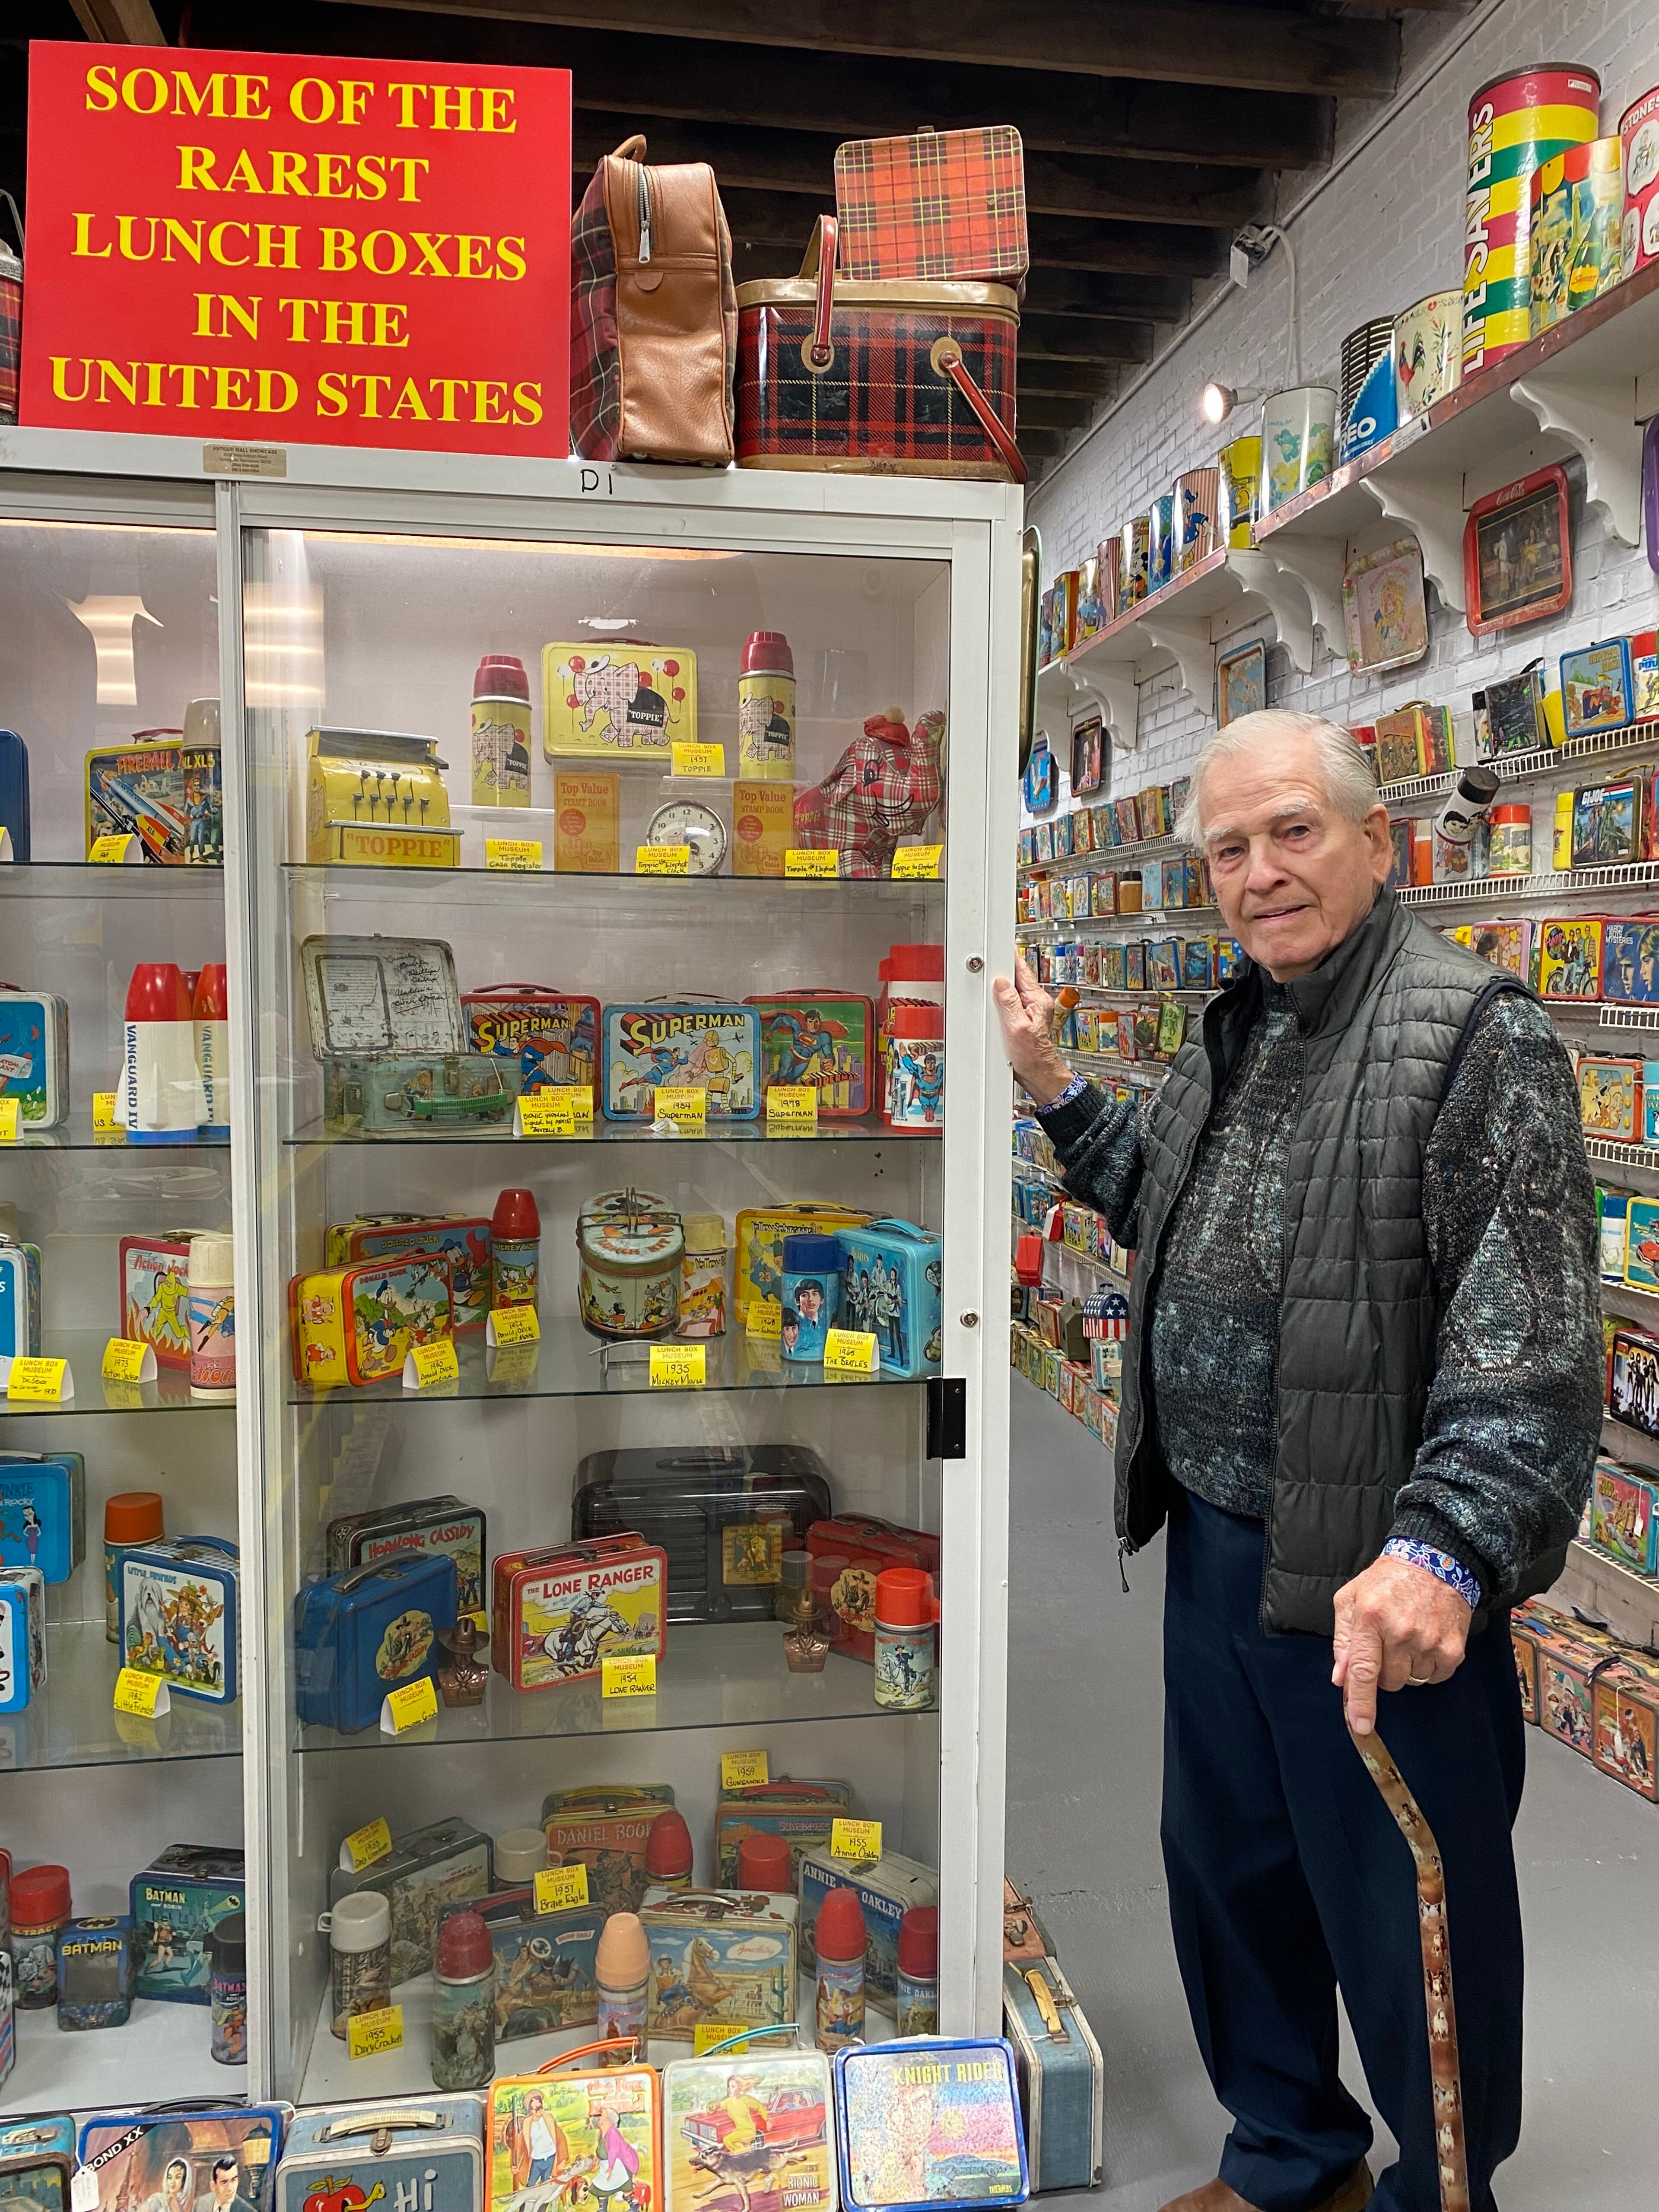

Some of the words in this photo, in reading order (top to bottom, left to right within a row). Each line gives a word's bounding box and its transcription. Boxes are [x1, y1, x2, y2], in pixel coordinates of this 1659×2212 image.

[86, 65, 270, 120] SOME
[289, 77, 374, 125] OF
[388, 83, 516, 133] THE
[176, 145, 429, 202] RAREST
[1465, 102, 1494, 276] SAVERS
[71, 212, 302, 270] LUNCH
[319, 227, 526, 281] BOXES
[193, 293, 261, 340] IN
[280, 300, 409, 347] THE
[1464, 280, 1487, 375] LIFE
[49, 357, 299, 413] UNITED
[316, 372, 543, 425] STATES
[628, 710, 663, 721] "TOPPIE"
[116, 750, 174, 775] FIREBALL
[194, 752, 215, 769] XL5
[561, 783, 578, 796] Top
[582, 783, 608, 794] Value
[740, 790, 756, 803] Top
[759, 791, 785, 801] Value
[347, 834, 450, 858] "TOPPIE"
[476, 1017, 570, 1052] SUPERMAN
[630, 1014, 745, 1056] SUPERMAN
[127, 1025, 137, 1107] VANGUARD
[128, 1112, 137, 1128] IV
[751, 1222, 772, 1233] Yellow
[774, 1223, 814, 1234] Submarine
[381, 1238, 415, 1248] DONALD
[417, 1235, 439, 1243] DUCK
[135, 1255, 163, 1271] Action
[359, 1273, 386, 1284] DONALD
[759, 1271, 771, 1282] 23
[666, 1364, 689, 1373] 1935
[839, 1357, 868, 1368] BEATLES
[430, 1524, 475, 1545] CASSIDY
[528, 1586, 540, 1595] THE
[543, 1578, 581, 1599] LONE
[588, 1565, 654, 1590] RANGER
[726, 1777, 765, 1786] GUNSMOKE
[557, 1828, 609, 1844] DANIEL
[616, 1825, 648, 1839] BOO
[849, 1838, 867, 1847] 1955
[834, 1847, 856, 1857] Annie
[547, 1874, 575, 1883] MUSEUM
[146, 1888, 185, 1903] BATMAN
[555, 1885, 574, 1895] 1957
[804, 1864, 836, 1888] ANNIE
[862, 1891, 903, 1919] OAKLEY
[540, 1898, 563, 1910] Brave
[565, 1888, 585, 1904] Eagle
[62, 1941, 122, 1955] BATMAN
[365, 2029, 385, 2041] 1955
[893, 2065, 950, 2085] KNIGHT
[957, 2062, 1003, 2083] RIDER
[123, 2126, 144, 2145] XX
[788, 2175, 818, 2189] BIONIC
[394, 2169, 437, 2212] Hi
[783, 2192, 819, 2206] WOMAN
